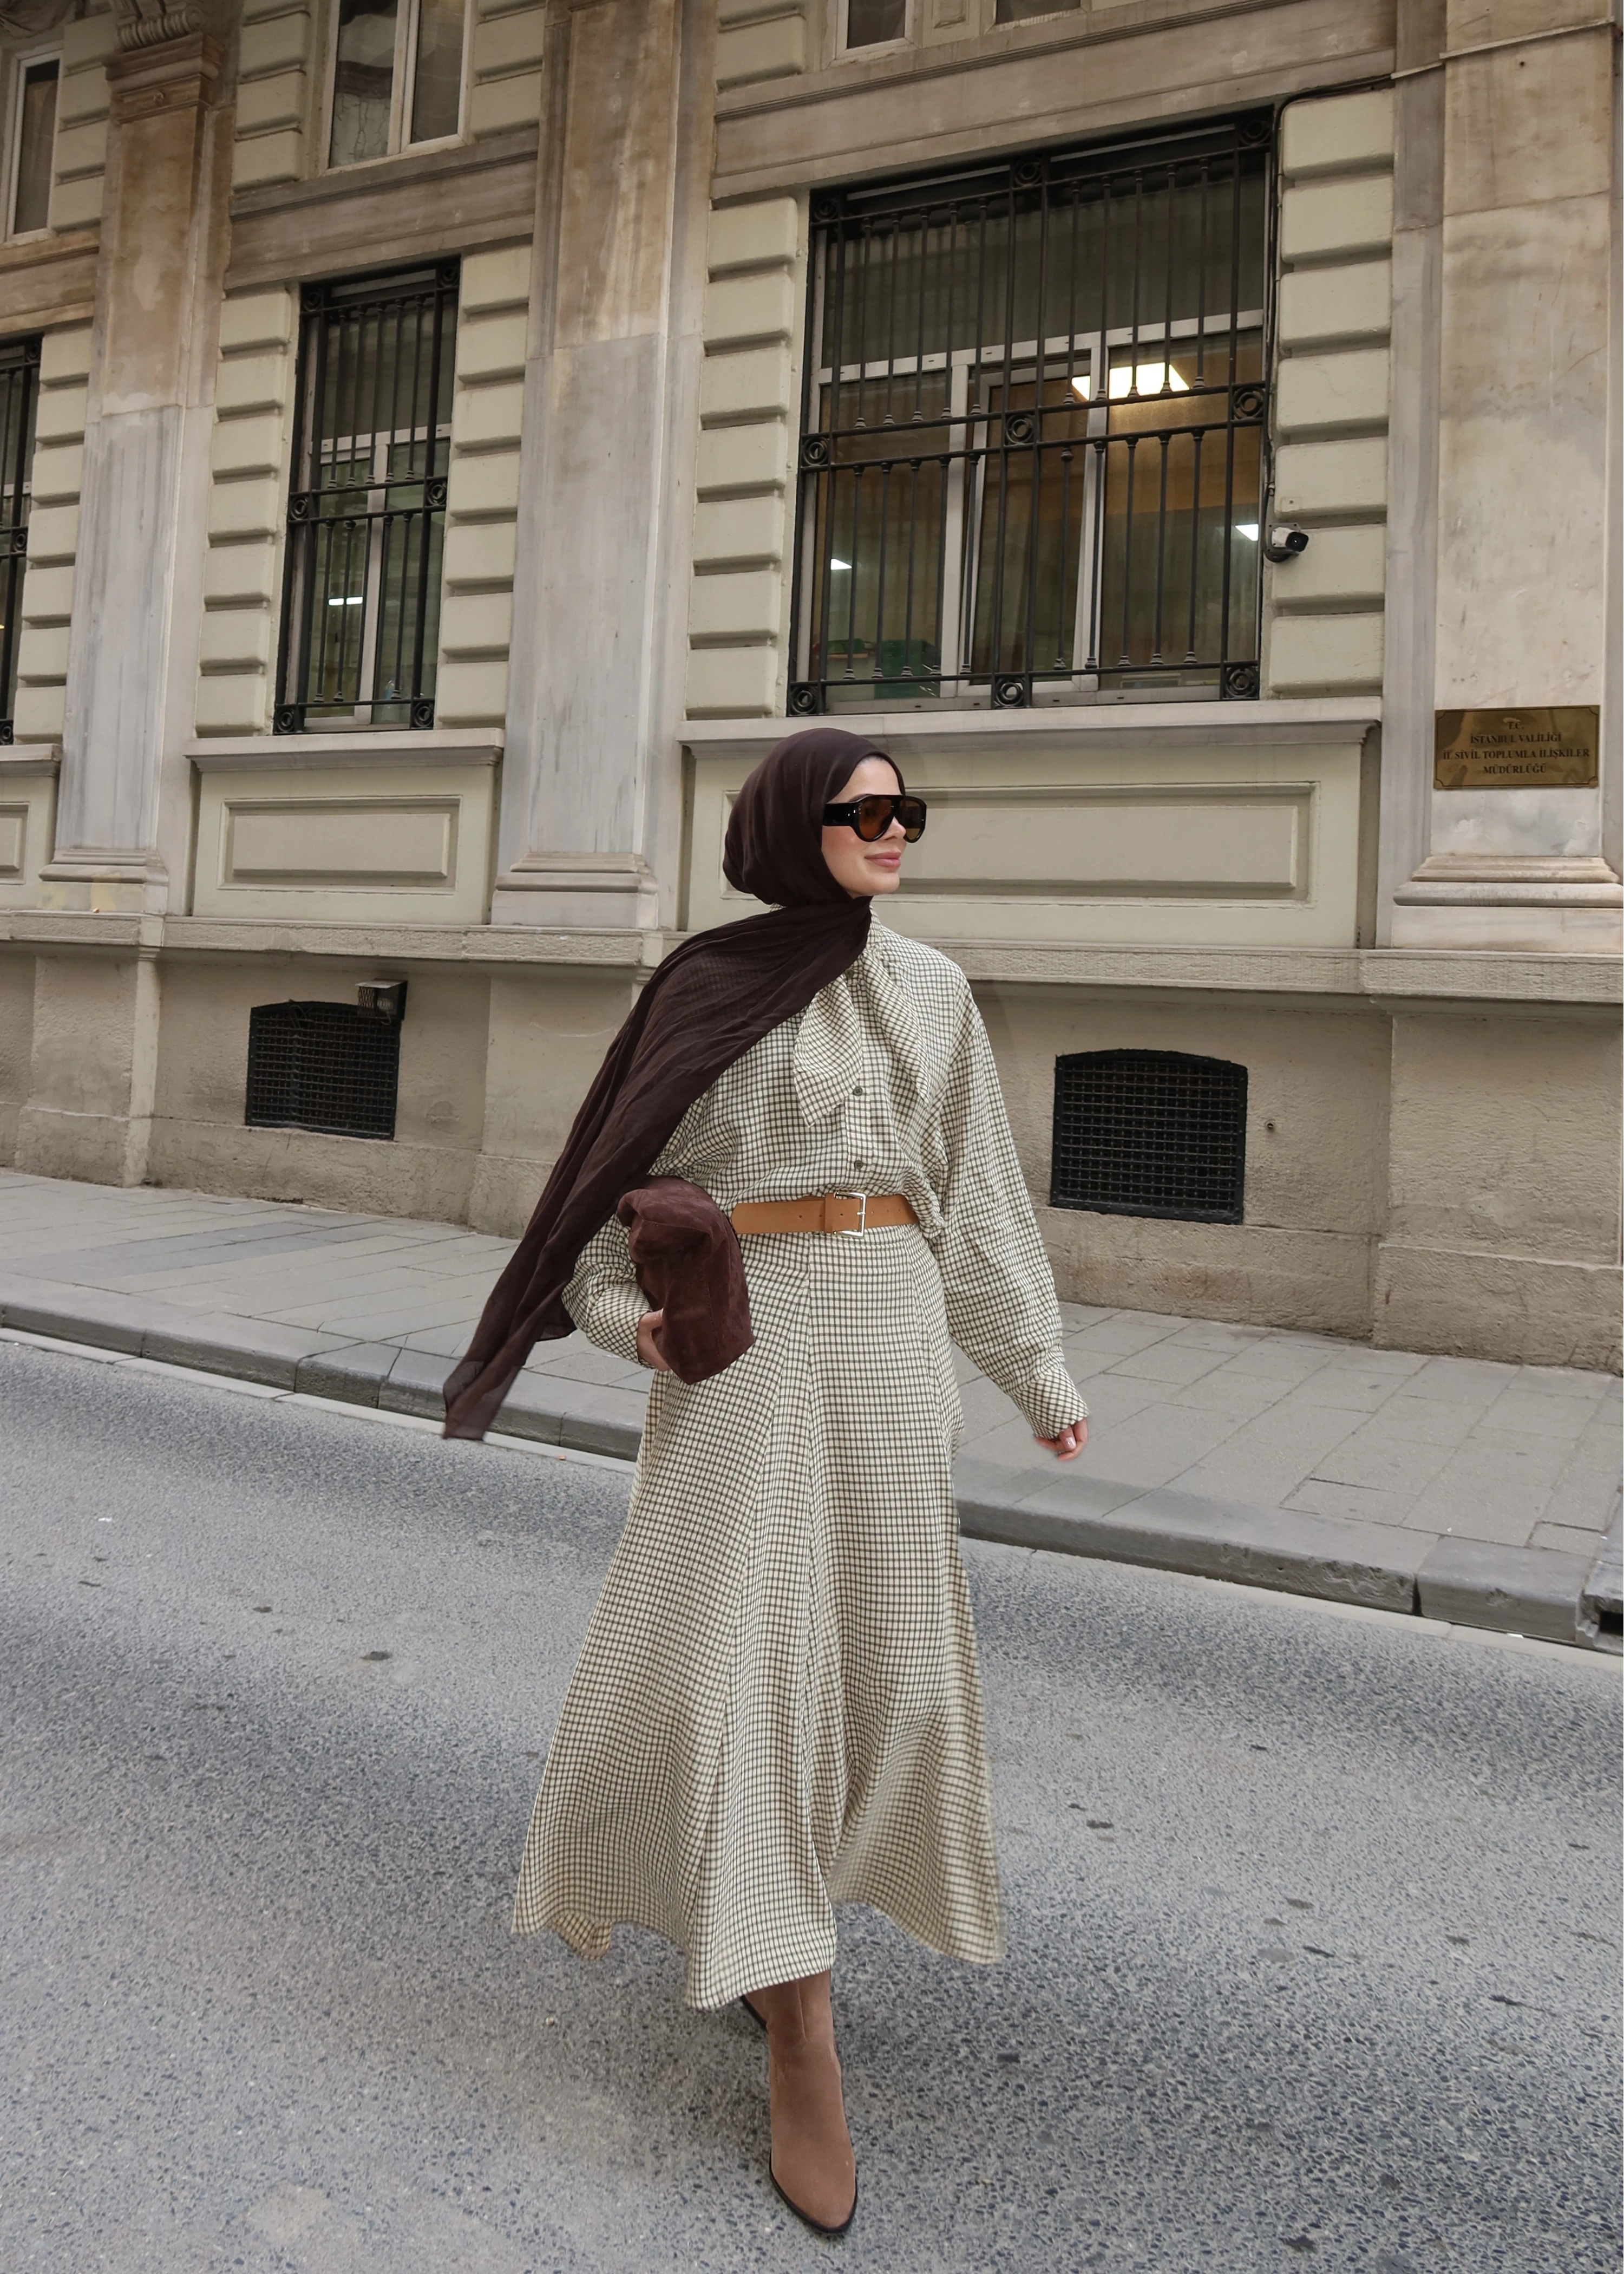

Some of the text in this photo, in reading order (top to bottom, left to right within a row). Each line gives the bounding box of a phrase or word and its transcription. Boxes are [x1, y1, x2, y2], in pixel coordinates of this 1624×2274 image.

[1470, 731, 1562, 744] İSTANBUL VALİLİĞİ
[1455, 749, 1481, 759] SİVİL
[1483, 750, 1536, 759] TOPLUMLA
[1539, 747, 1589, 759] İLİŞKİLER
[1483, 763, 1547, 774] MÜDÜRLÜĞÜ
